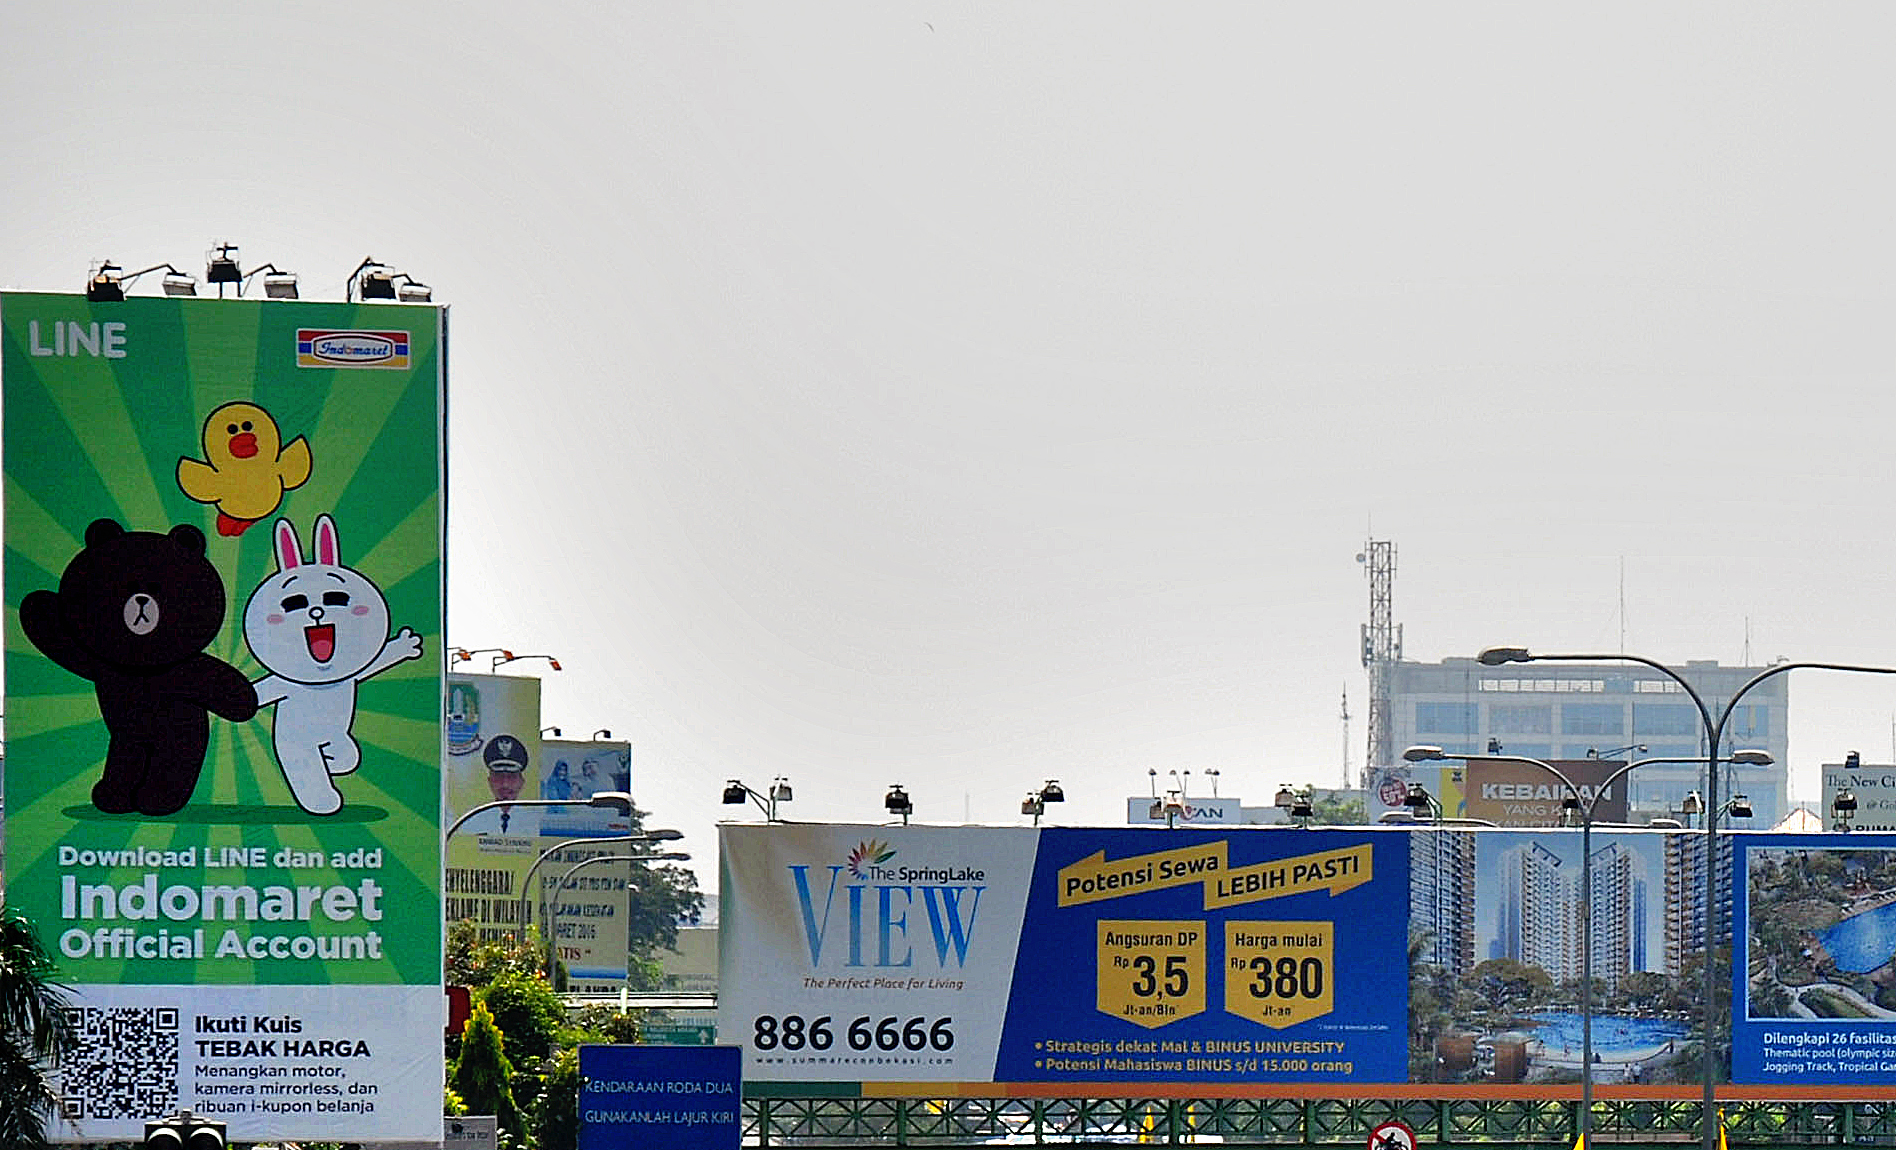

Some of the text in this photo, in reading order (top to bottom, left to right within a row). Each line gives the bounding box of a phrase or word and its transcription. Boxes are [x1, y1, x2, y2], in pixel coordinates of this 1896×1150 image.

[29, 321, 126, 357] LINE
[1850, 777, 1879, 787] New
[59, 847, 381, 868] Download LINE dan add
[869, 866, 984, 884] The SpringLake
[1066, 855, 1219, 897] Potensi Sewa
[1216, 855, 1359, 898] LEBIH PASTI
[60, 874, 382, 920] Indomaret
[787, 865, 987, 969] VIEW
[60, 929, 381, 959] Official Account
[1105, 932, 1198, 949] Angsuran DP
[1236, 932, 1322, 949] Harga mulai
[803, 977, 964, 991] The Perfect Place for Living
[1114, 955, 1189, 1000] Rp 3,5
[1231, 957, 1323, 1000] Rp 380
[195, 1016, 302, 1034] Ikuti Kuis
[754, 1015, 954, 1051] 886 6666
[1046, 1040, 1344, 1054] Strategis dekat Mal & BINUS UNIVERSITY
[1764, 1032, 1829, 1046] Dilengkapi
[1832, 1033, 1846, 1044] 26
[195, 1041, 370, 1057] TEBAK HARGA
[195, 1065, 346, 1080] Menangkan motor,
[1047, 1058, 1352, 1074] Potensi Mahasiswa BINUS s/d 15.000 orang
[195, 1082, 378, 1097] kamera mirrorless, dan
[585, 1080, 733, 1094] KENDARAAN RODA DUA
[195, 1100, 374, 1116] ribuan i-kupon belanja
[585, 1110, 734, 1127] GUNAKANLAH LAJUR KIRI
